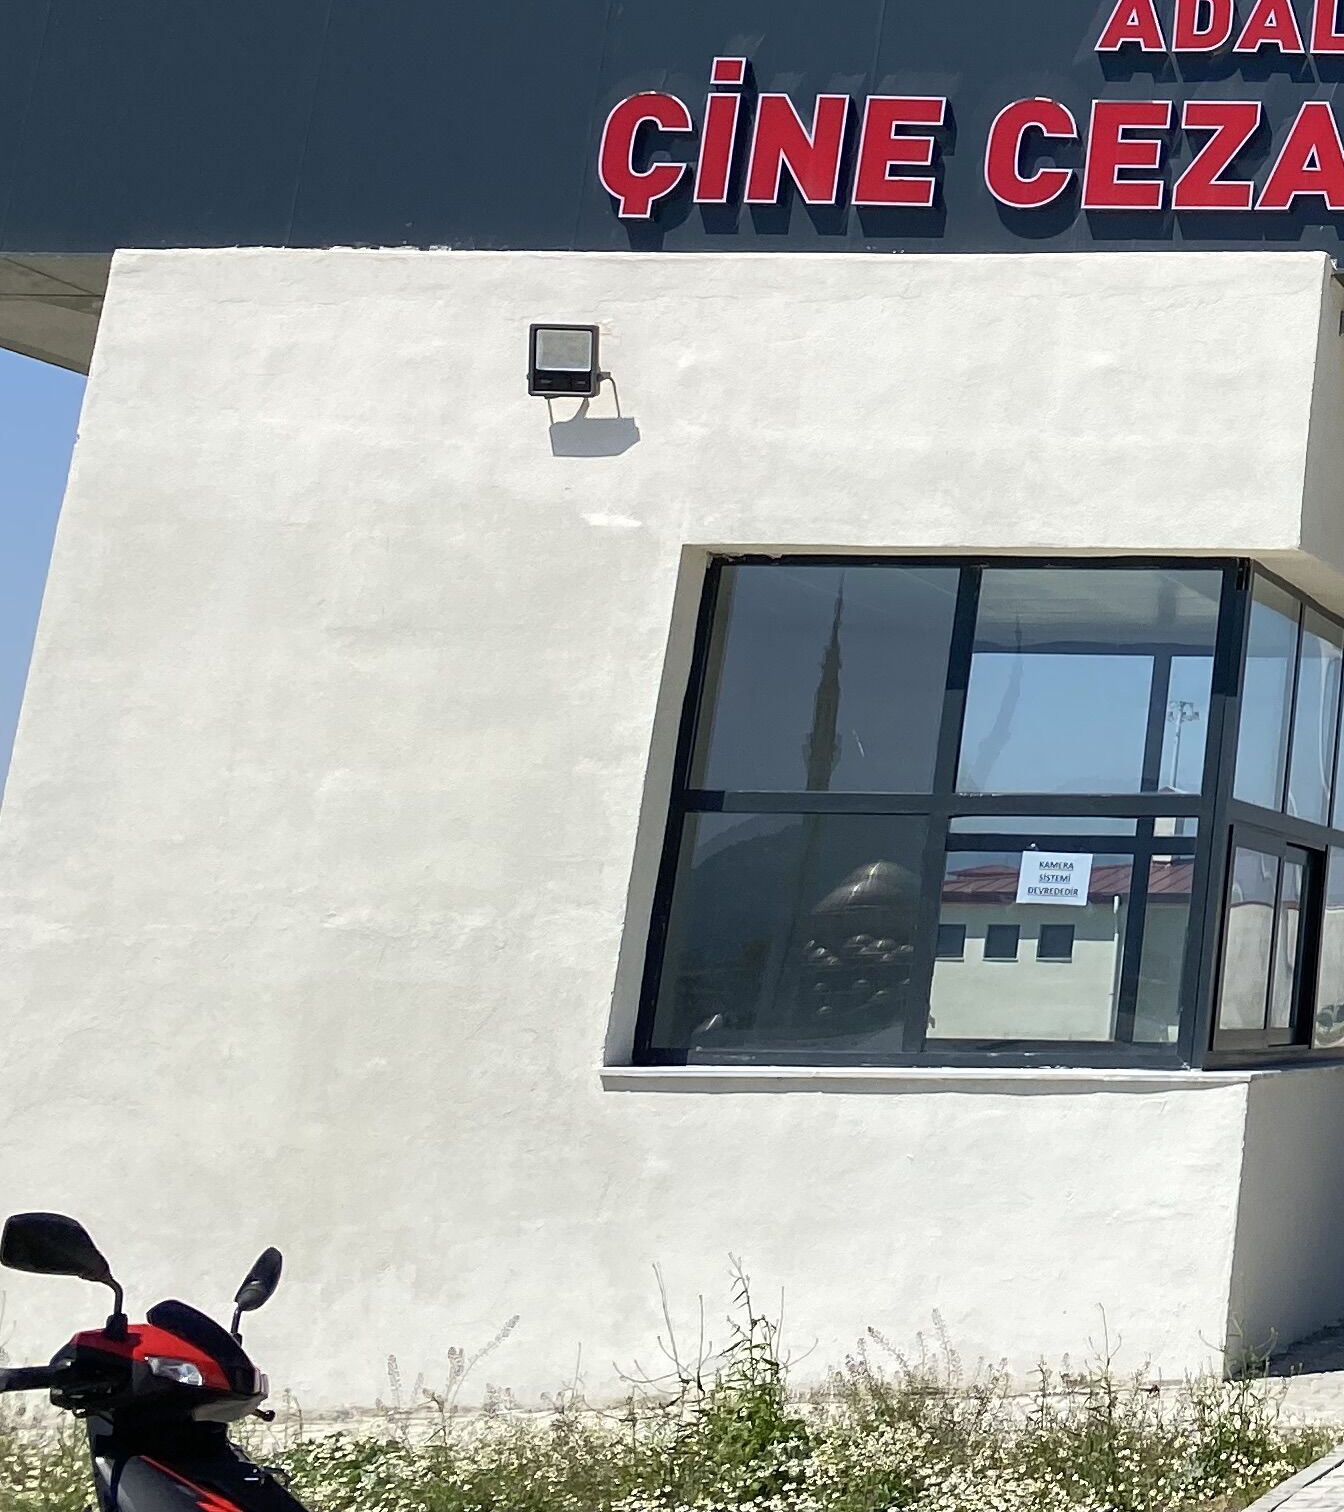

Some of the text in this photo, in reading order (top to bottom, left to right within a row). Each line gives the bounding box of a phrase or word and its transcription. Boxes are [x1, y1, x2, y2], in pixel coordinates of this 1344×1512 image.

[598, 56, 947, 219] ÇİNE
[1039, 861, 1074, 870] KAMERA
[1039, 873, 1071, 883] SİSTEMİ
[1027, 886, 1079, 896] DEVREDEDİR
